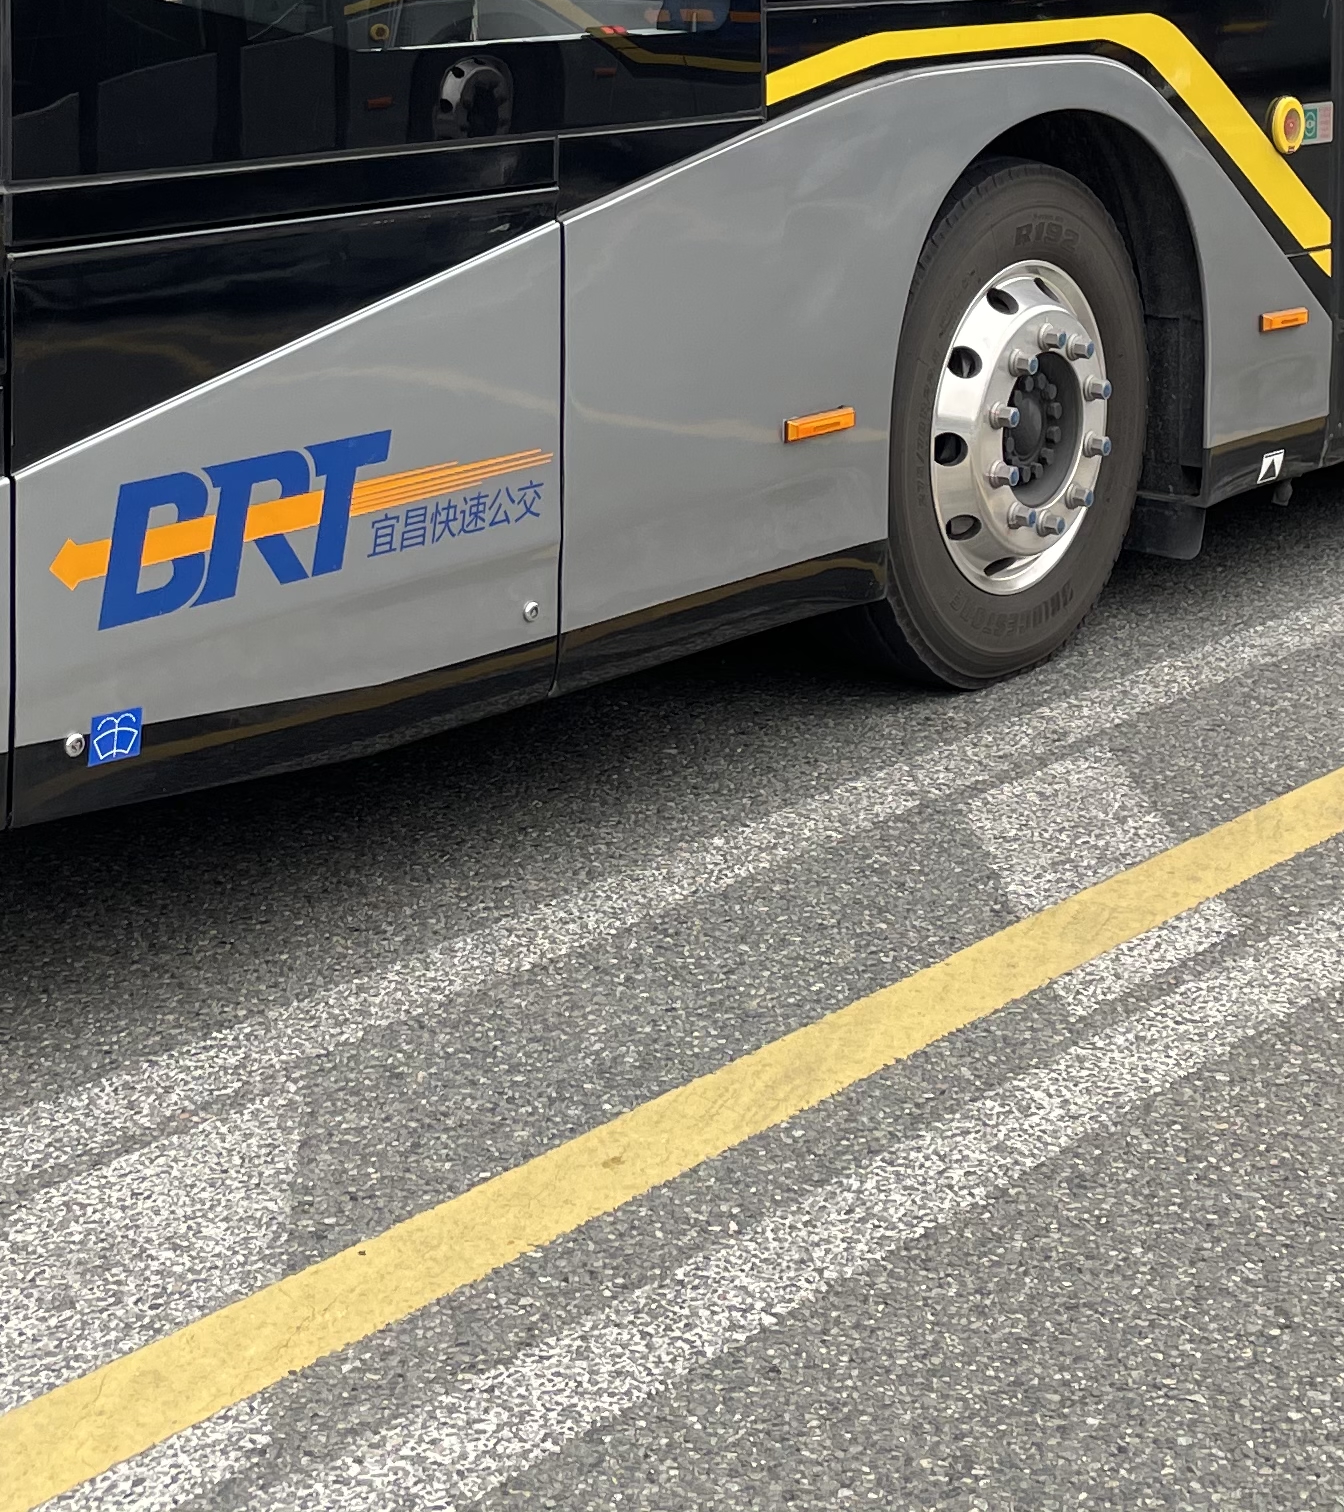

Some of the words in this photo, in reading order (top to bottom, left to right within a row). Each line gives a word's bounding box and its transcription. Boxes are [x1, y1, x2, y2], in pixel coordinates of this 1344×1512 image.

[1014, 221, 1080, 253] R192
[98, 429, 393, 630] BRT
[367, 480, 545, 559] 宜昌快速公交
